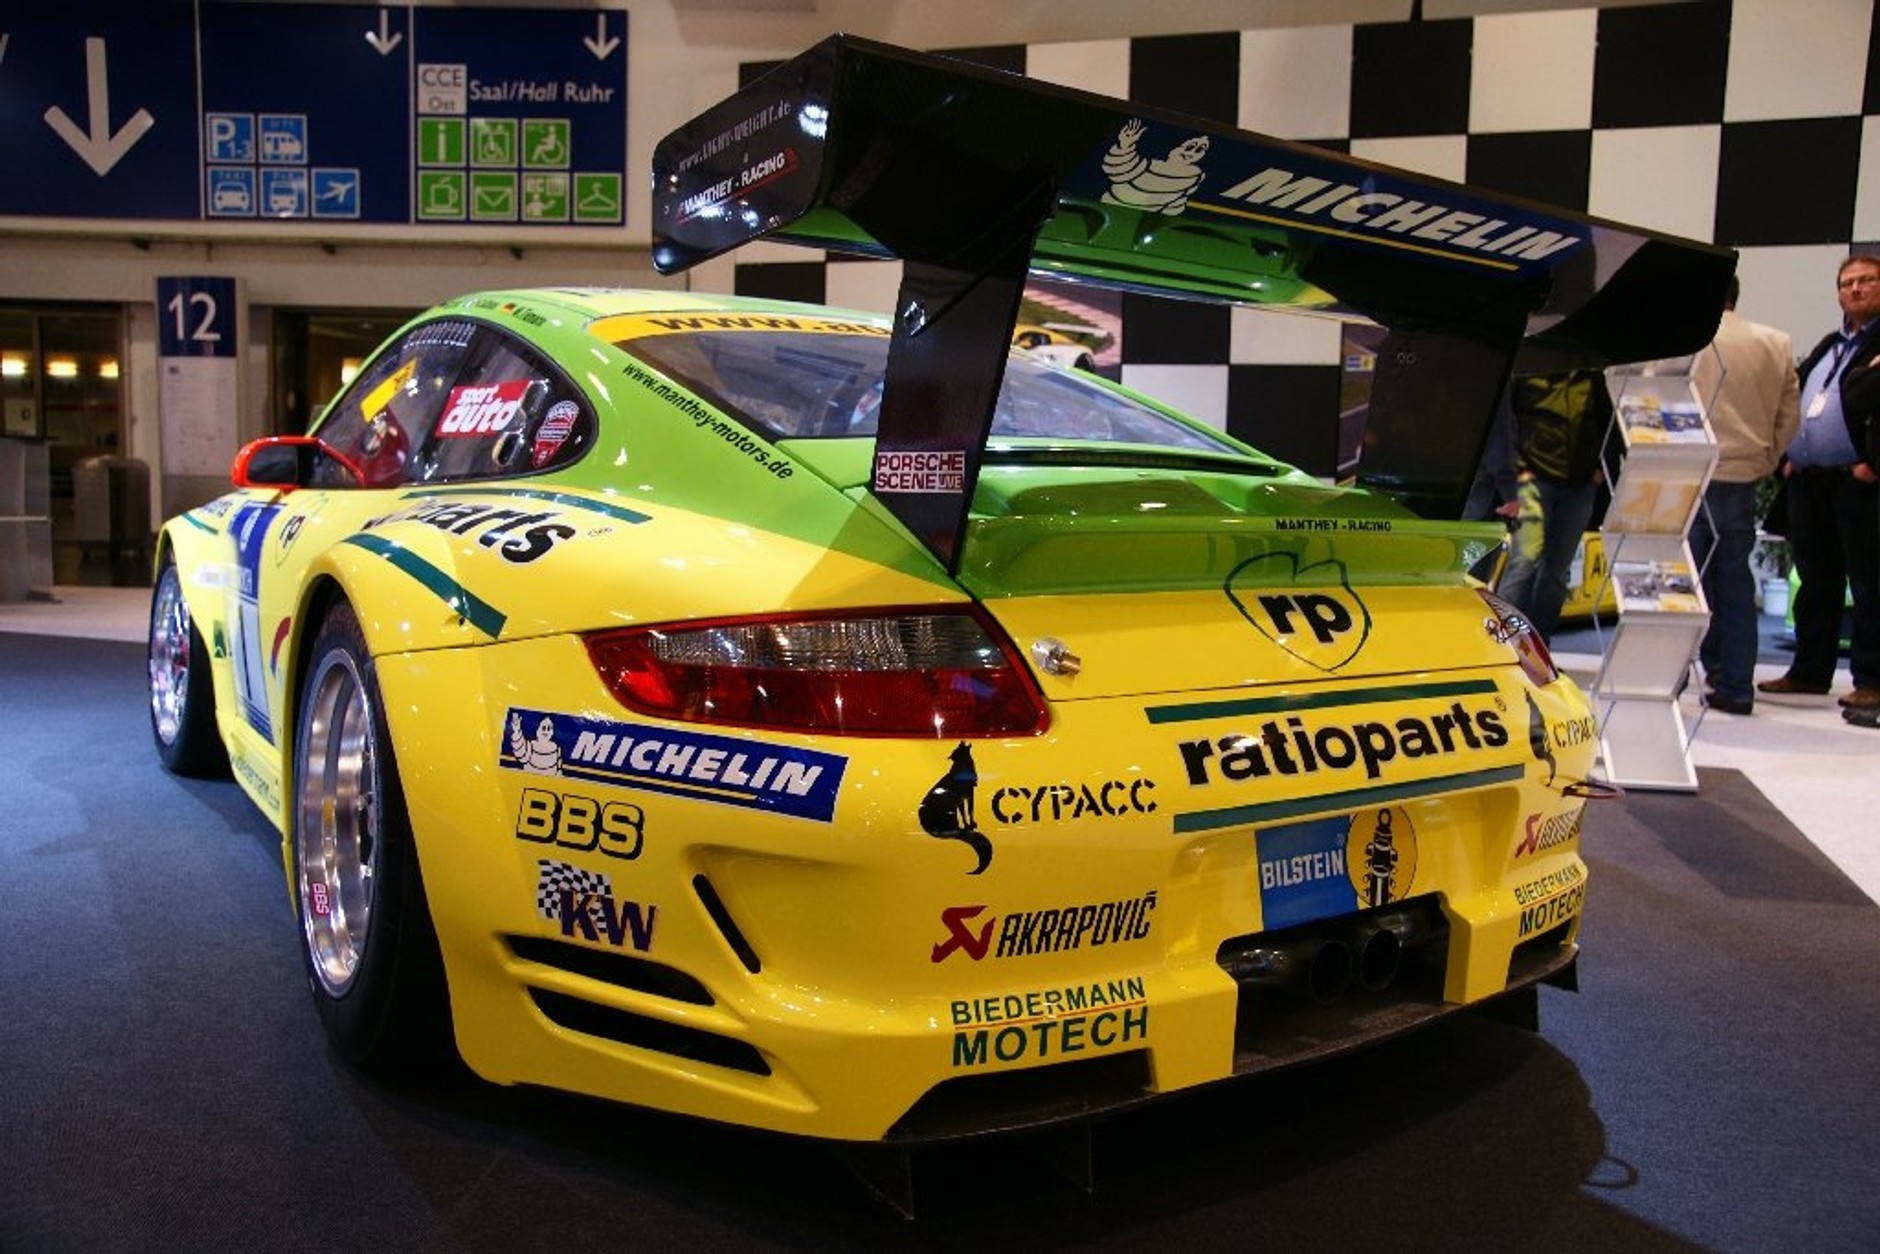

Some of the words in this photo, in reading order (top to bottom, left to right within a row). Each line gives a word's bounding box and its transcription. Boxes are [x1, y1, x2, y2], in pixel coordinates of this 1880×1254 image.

[422, 68, 463, 88] CCE
[564, 81, 615, 103] Ruhr
[428, 96, 455, 112] Ost
[212, 118, 236, 157] P
[1220, 167, 1580, 262] MICHELIN
[168, 292, 222, 341] 12
[440, 397, 520, 433] auto
[622, 363, 795, 480] www.manthey-motors.de
[876, 473, 937, 490] SCENE
[877, 453, 963, 471] PORSCHE
[1257, 593, 1353, 643] rp
[570, 730, 823, 797] MICHELIN
[1178, 702, 1509, 787] ratioparts
[516, 787, 645, 861] BBS
[990, 778, 1158, 824] CYPACC
[1261, 849, 1345, 890] BILSTEIN
[1514, 862, 1582, 906] BIEDERMANN
[560, 886, 657, 953] KW
[1518, 883, 1584, 938] MOTECH
[951, 976, 1146, 1027] BIEDERMANN
[952, 1005, 1149, 1067] MOTECH
